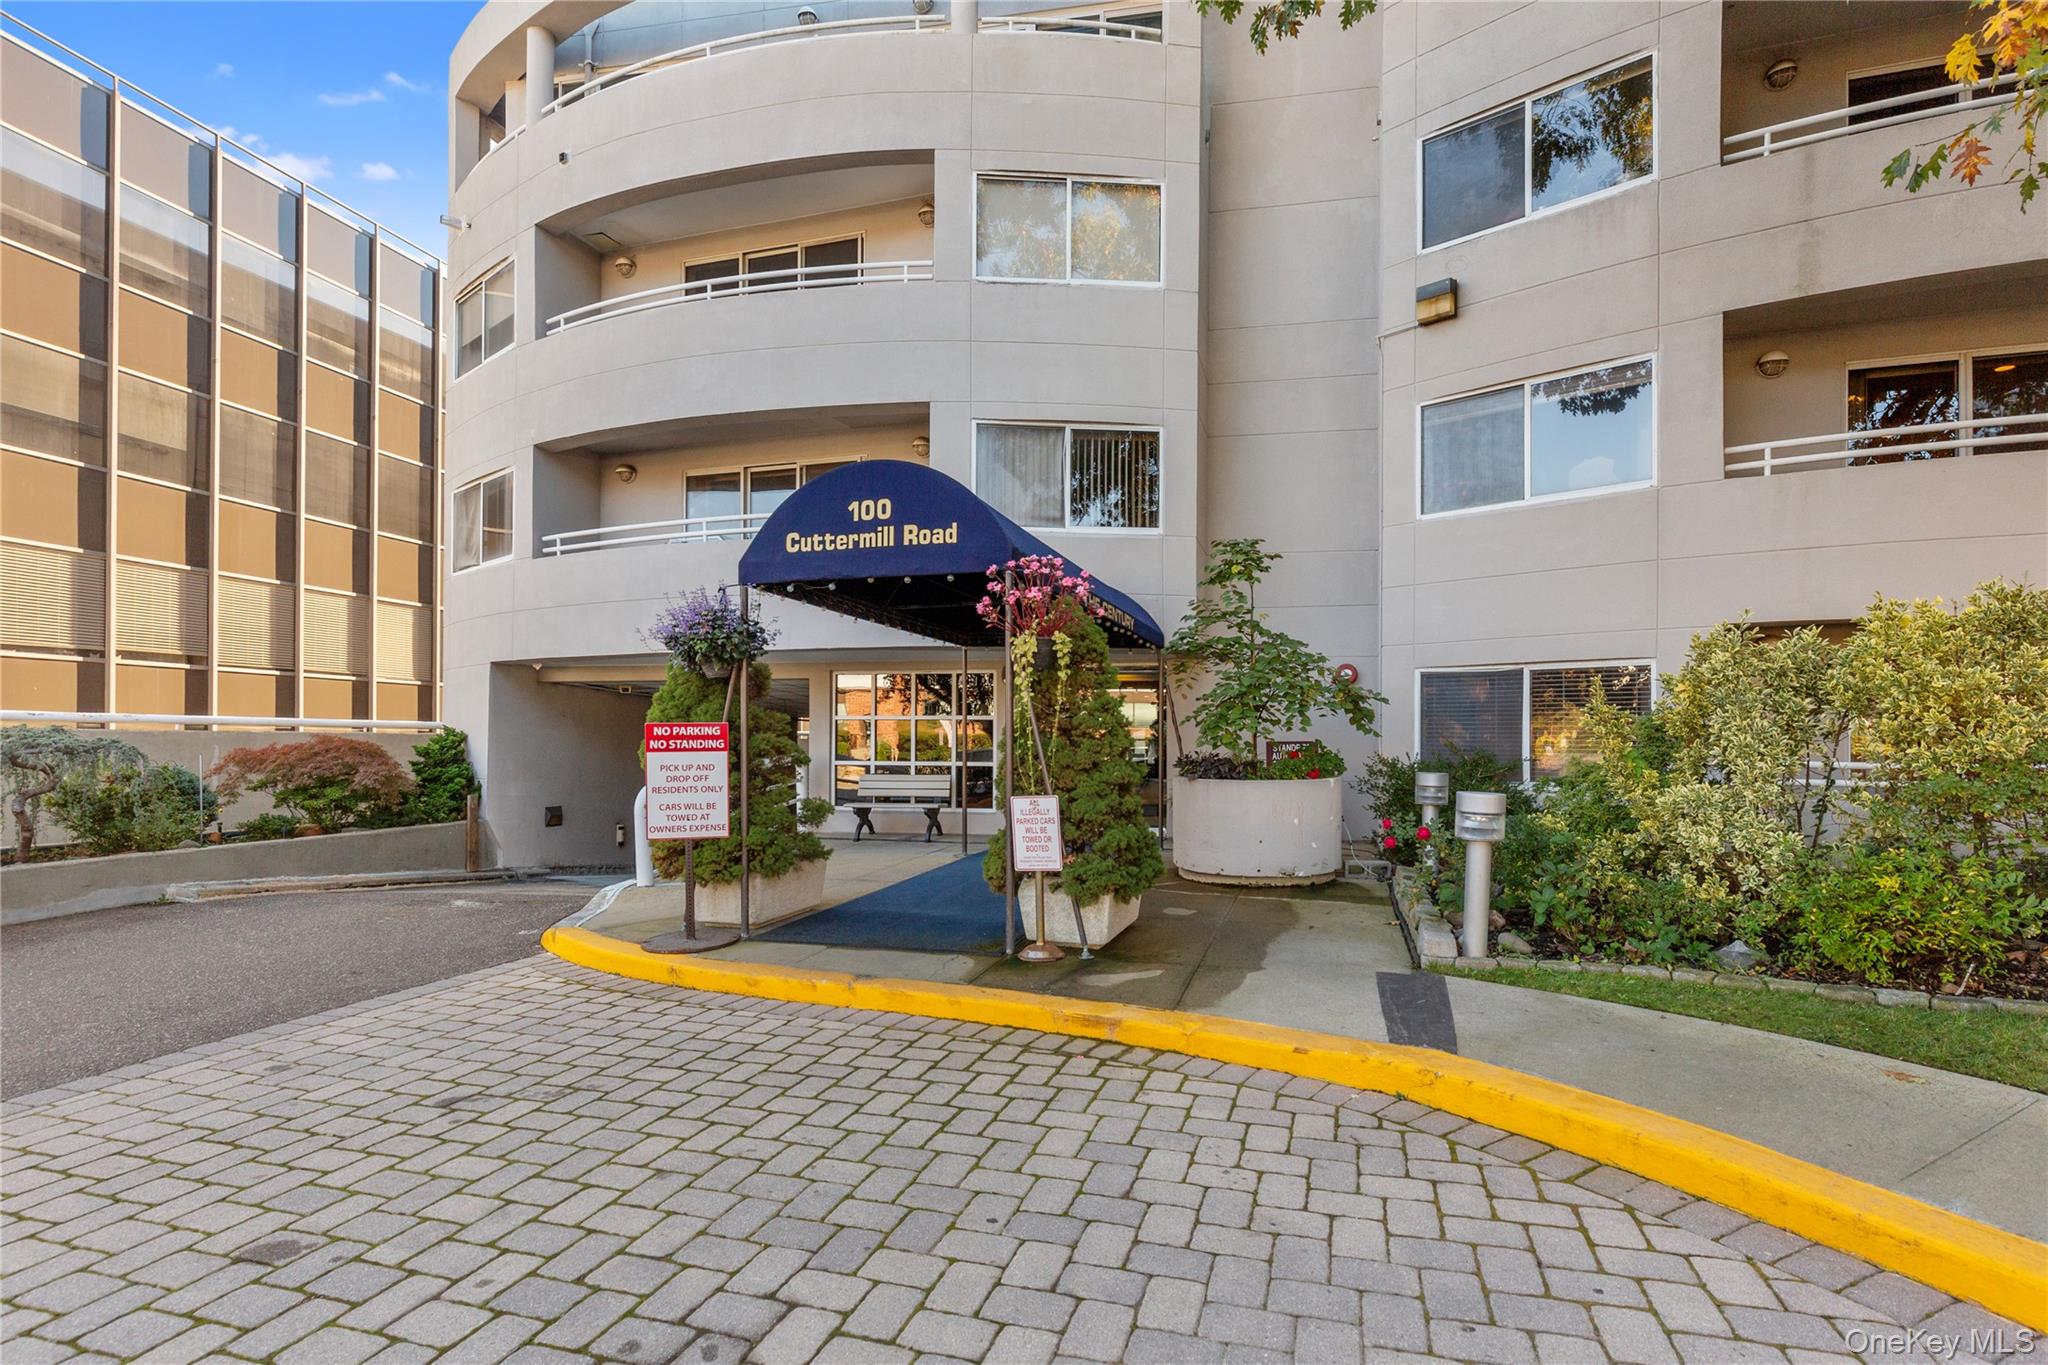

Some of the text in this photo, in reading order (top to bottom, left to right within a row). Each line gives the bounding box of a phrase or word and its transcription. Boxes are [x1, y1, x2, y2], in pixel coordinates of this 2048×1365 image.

[848, 498, 892, 522] 100
[785, 522, 958, 553] Cuttermill Road
[653, 726, 721, 736] NO PARKING
[649, 739, 725, 749] NO STANDING
[660, 763, 716, 772] PICK UP AND
[666, 774, 710, 783] DROP OFF
[651, 785, 724, 794] RESIDENTS ONLY
[658, 803, 682, 811] CARS
[706, 802, 717, 810] BE
[1020, 808, 1050, 816] ILLEGALLY
[666, 813, 711, 822] TOWED AT
[1040, 817, 1056, 825] CARS
[649, 823, 727, 833] OWNERS EXPENSE
[1025, 826, 1048, 834] WILL BE
[1022, 835, 1052, 844] TOWED OR
[1025, 845, 1050, 853] BOOTED
